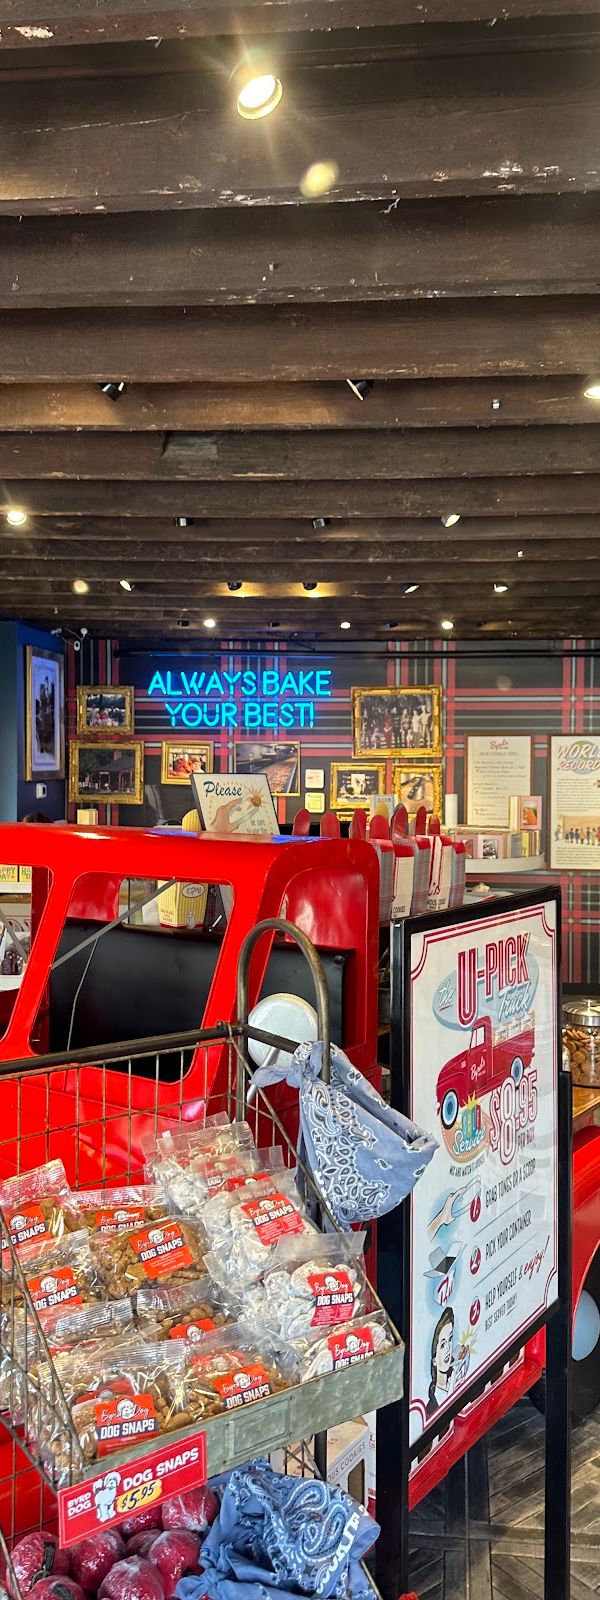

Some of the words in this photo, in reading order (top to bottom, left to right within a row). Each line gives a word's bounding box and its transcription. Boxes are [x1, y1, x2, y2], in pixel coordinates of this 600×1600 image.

[148, 670, 257, 696] ALWAYS
[262, 670, 332, 696] BAKE
[165, 702, 238, 728] YOUR
[244, 701, 315, 728] BEST!
[203, 780, 243, 798] Please
[457, 931, 531, 1028] U-PICK
[497, 981, 531, 1021] Truck
[489, 1069, 539, 1166] $8.95
[452, 1123, 488, 1156] Service
[485, 1185, 498, 1208] GRAB
[498, 1173, 512, 1199] TONGS
[512, 1170, 519, 1188] OR
[522, 1157, 536, 1181] SCOOP
[254, 1213, 270, 1226] DOG
[269, 1204, 294, 1220] SNAPS
[17, 1223, 46, 1242] SNAPS
[485, 1239, 496, 1261] PICK
[497, 1227, 509, 1253] YOUR
[509, 1209, 532, 1242] CONTAINER
[140, 1248, 157, 1262] DOG
[156, 1237, 183, 1256] SNAPS
[47, 1285, 77, 1305] SNAPS
[317, 1294, 331, 1306] DOG
[331, 1292, 354, 1305] SNAPS
[485, 1286, 496, 1312] HELP
[497, 1268, 519, 1302] YOURSELF
[225, 1394, 243, 1409] DOG
[243, 1384, 271, 1403] SNAPS
[100, 1424, 121, 1440] DOG
[121, 1418, 155, 1436] SNAPS
[123, 1468, 153, 1491] DOG
[155, 1447, 199, 1477] SNAPS
[340, 1441, 366, 1471] COOKIES
[67, 1491, 92, 1508] BYRD
[67, 1499, 92, 1517] DOG
[120, 1481, 156, 1510] $5.95
